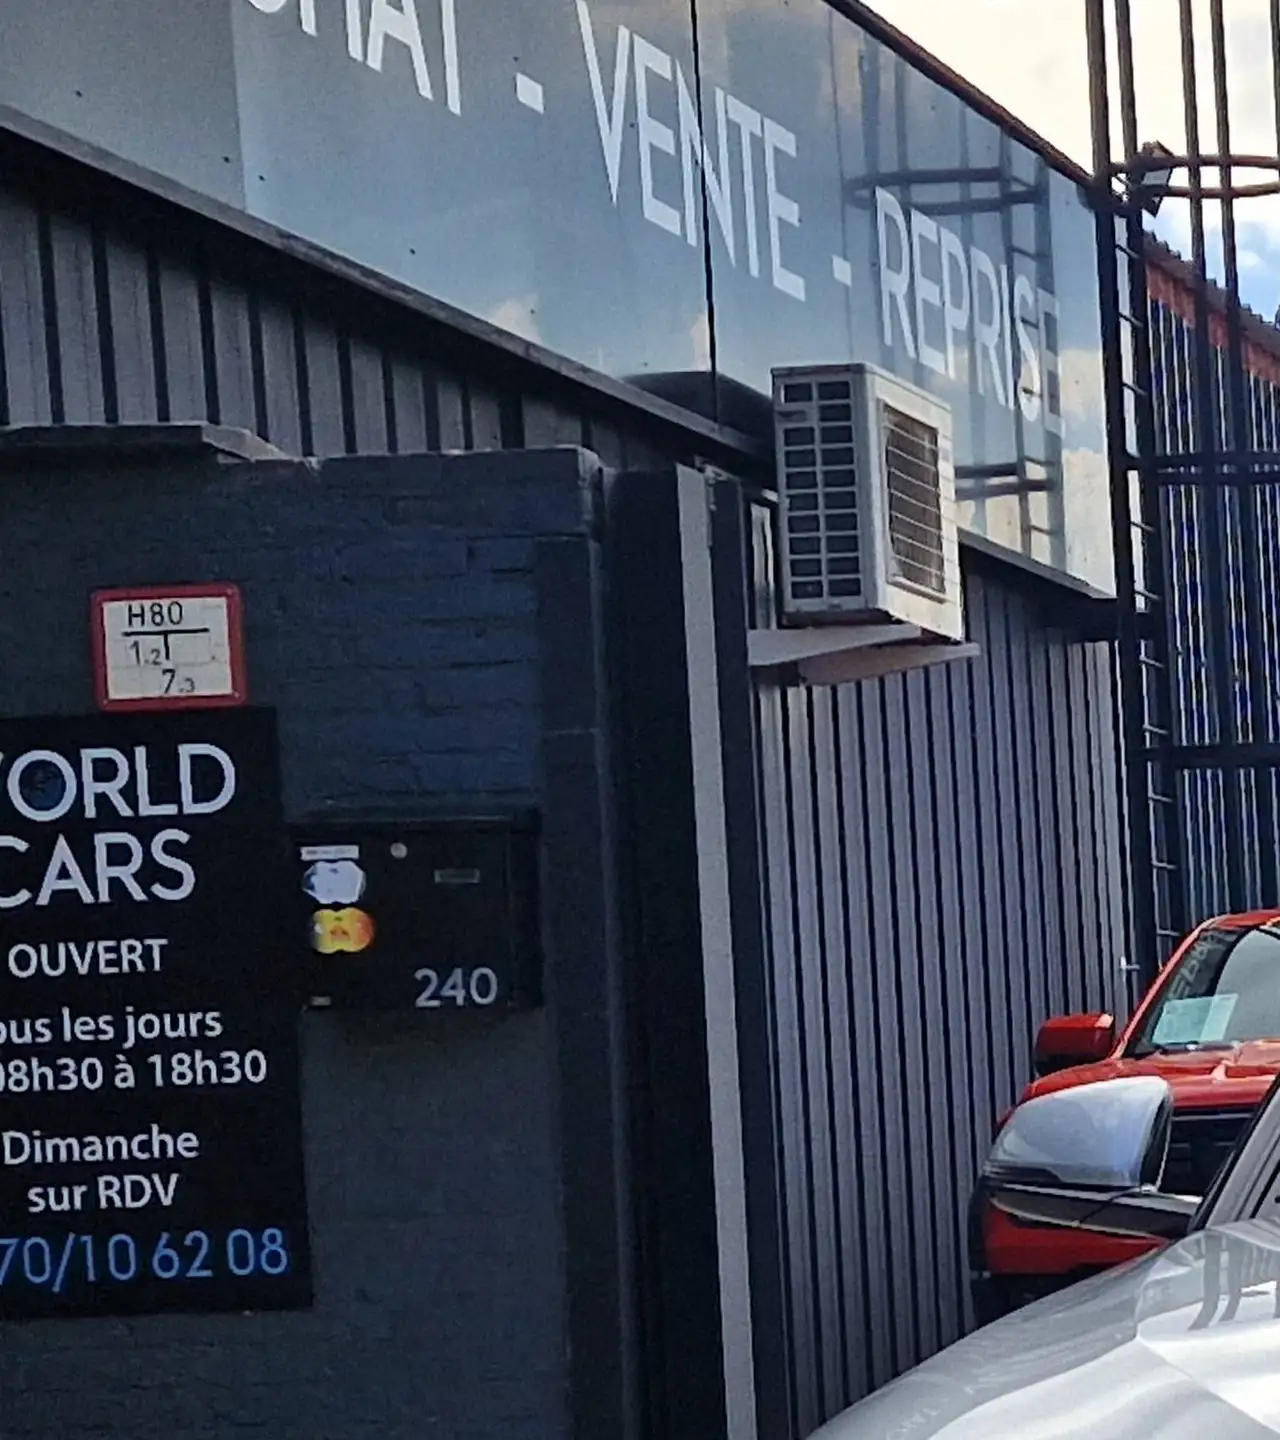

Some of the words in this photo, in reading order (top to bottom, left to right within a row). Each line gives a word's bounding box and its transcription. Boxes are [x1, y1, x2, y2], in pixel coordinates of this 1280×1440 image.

[576, 0, 805, 302] VENTE
[875, 186, 1067, 439] REPRISE
[128, 601, 183, 627] H80
[0, 743, 236, 822] ORLD
[8, 939, 168, 978] OUVERT
[414, 967, 498, 1008] 240
[61, 1006, 115, 1042] les
[122, 1006, 223, 1049] jours
[0, 1056, 104, 1092] 8h30
[114, 1054, 136, 1088] à
[147, 1049, 267, 1087] 18h30
[2, 1124, 200, 1165] Dimanche
[27, 1185, 88, 1213] sur
[97, 1173, 180, 1209] RDV
[152, 1230, 214, 1279] 62
[226, 1227, 288, 1276] 08
